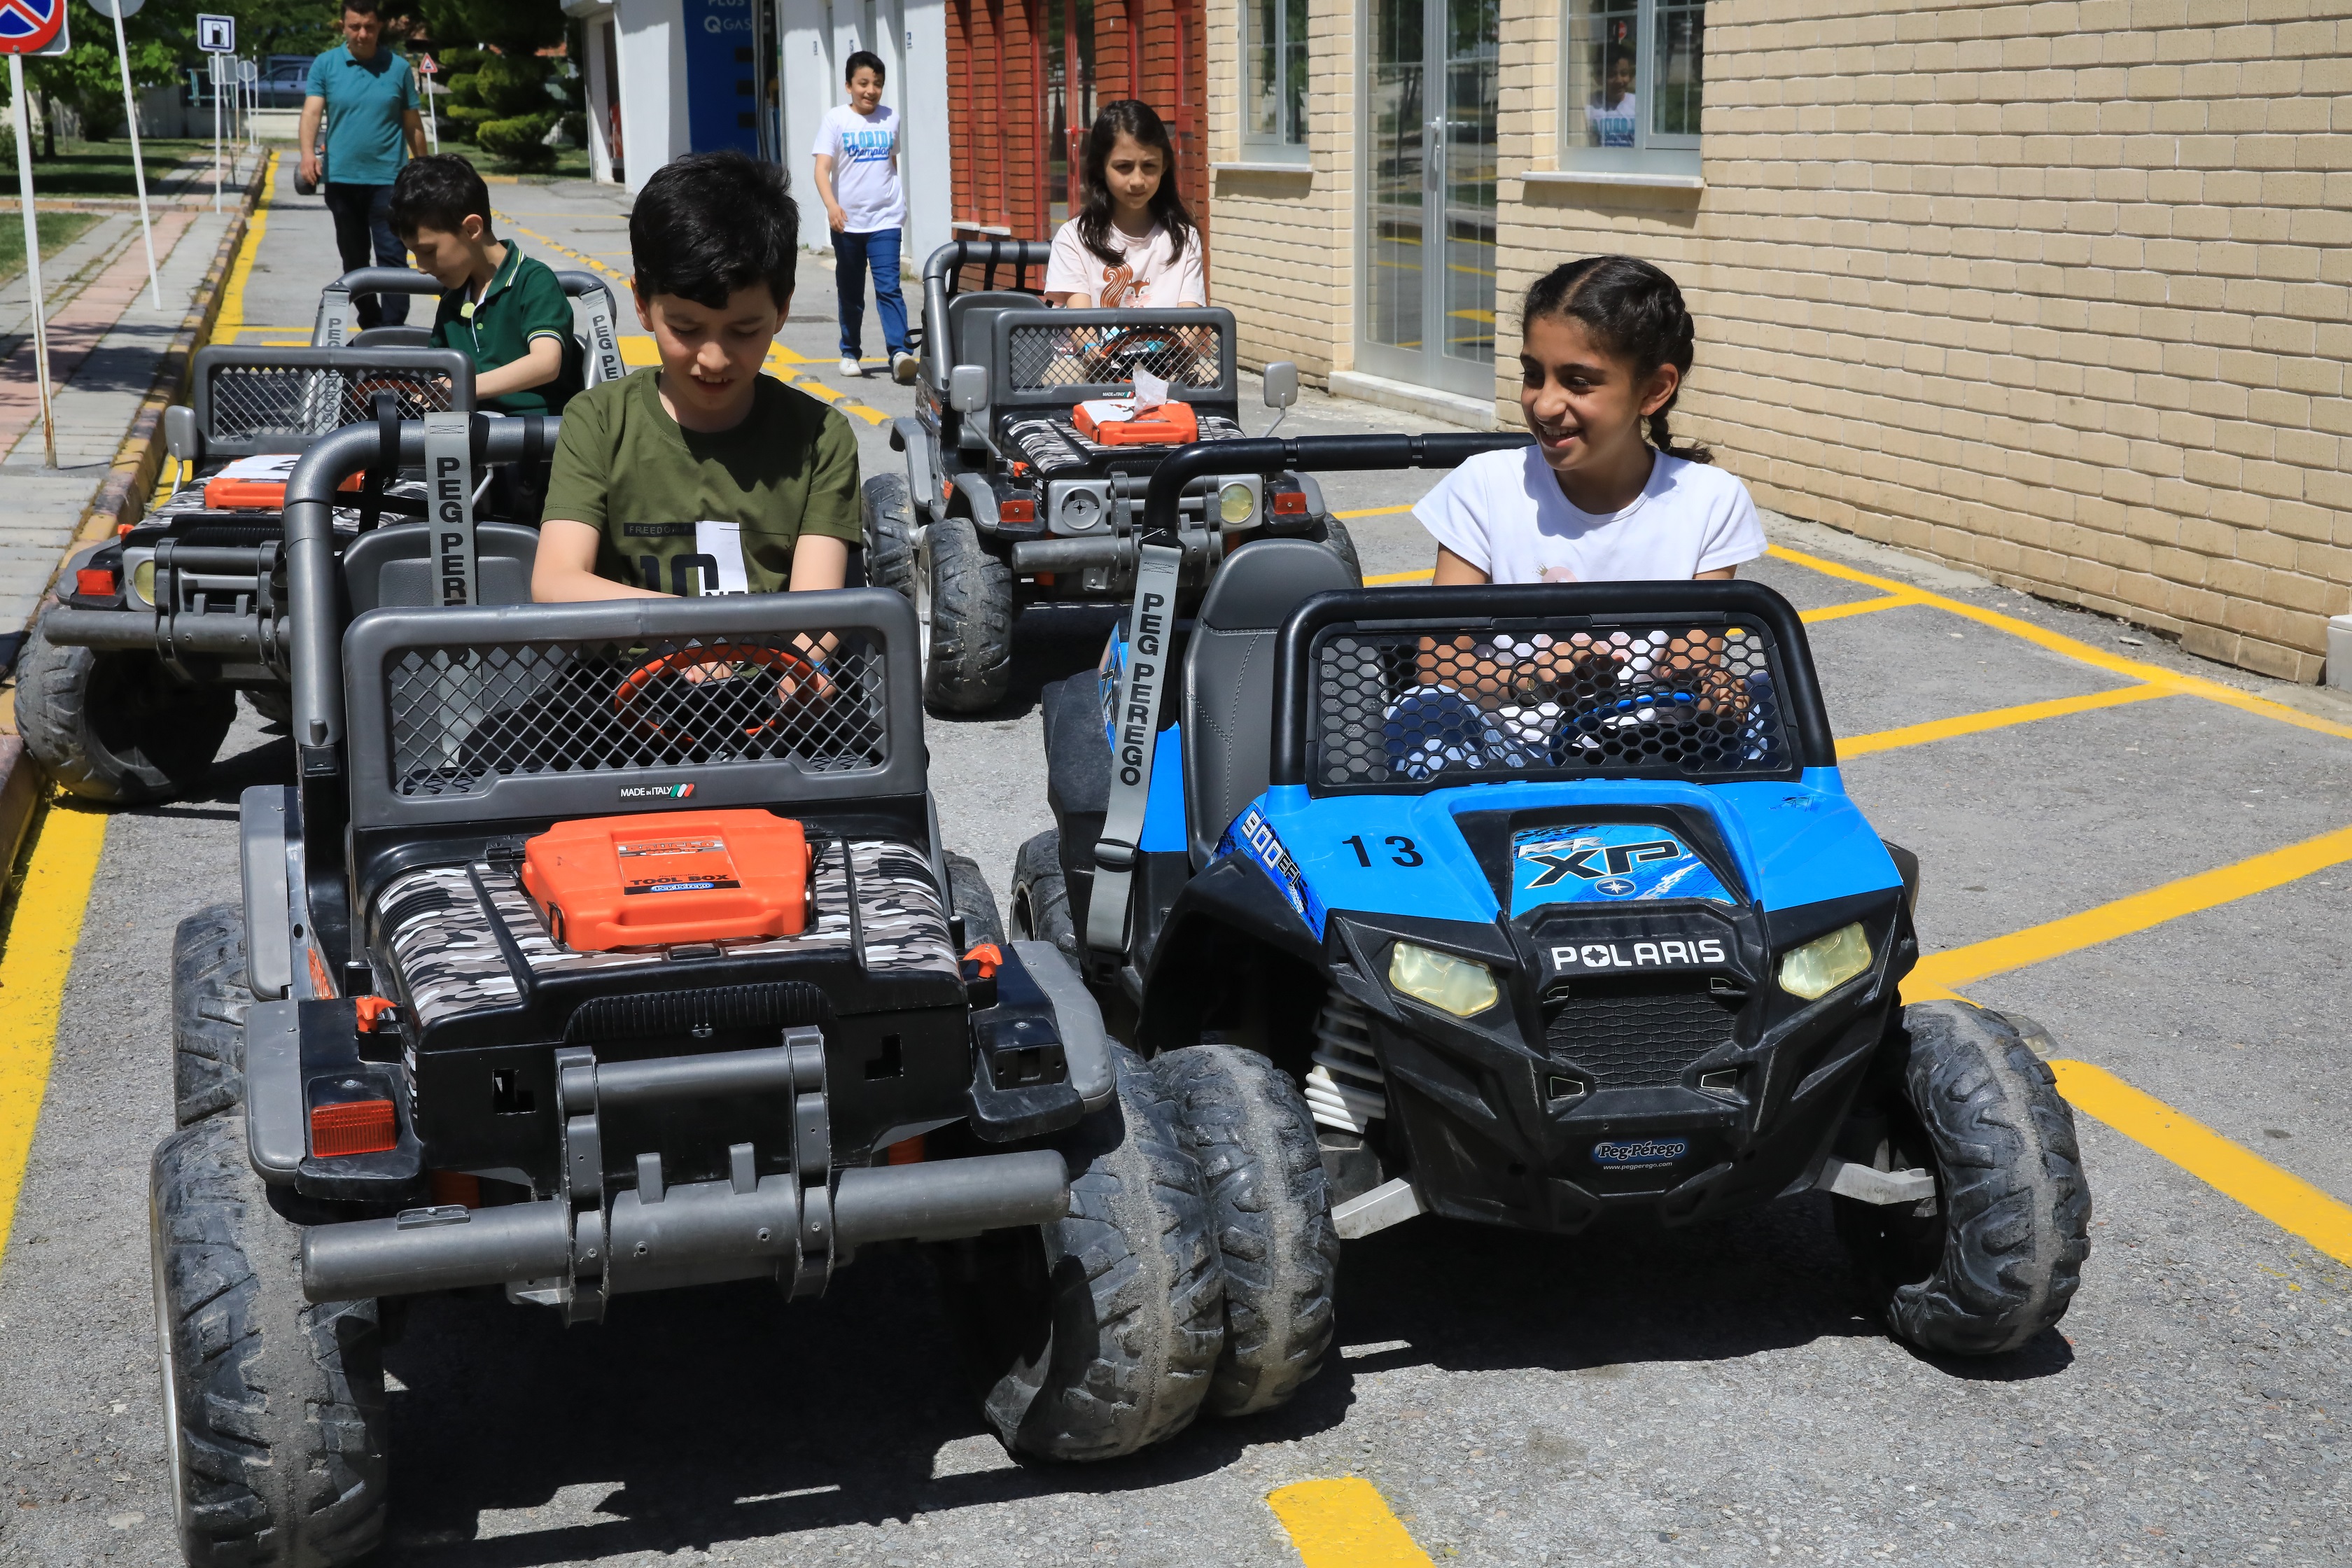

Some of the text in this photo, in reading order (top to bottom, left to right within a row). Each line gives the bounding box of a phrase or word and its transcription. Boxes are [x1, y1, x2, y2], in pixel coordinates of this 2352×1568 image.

[593, 315, 612, 349] PEG
[437, 457, 463, 524] PEG
[1120, 593, 1164, 785] PEG PEREGO
[621, 788, 645, 797] MADE
[652, 786, 673, 795] ITALY
[1241, 810, 1301, 885] 900 EFI
[1524, 839, 1680, 890] XP
[630, 877, 683, 886] TOOL
[1551, 939, 1726, 970] POLARIS
